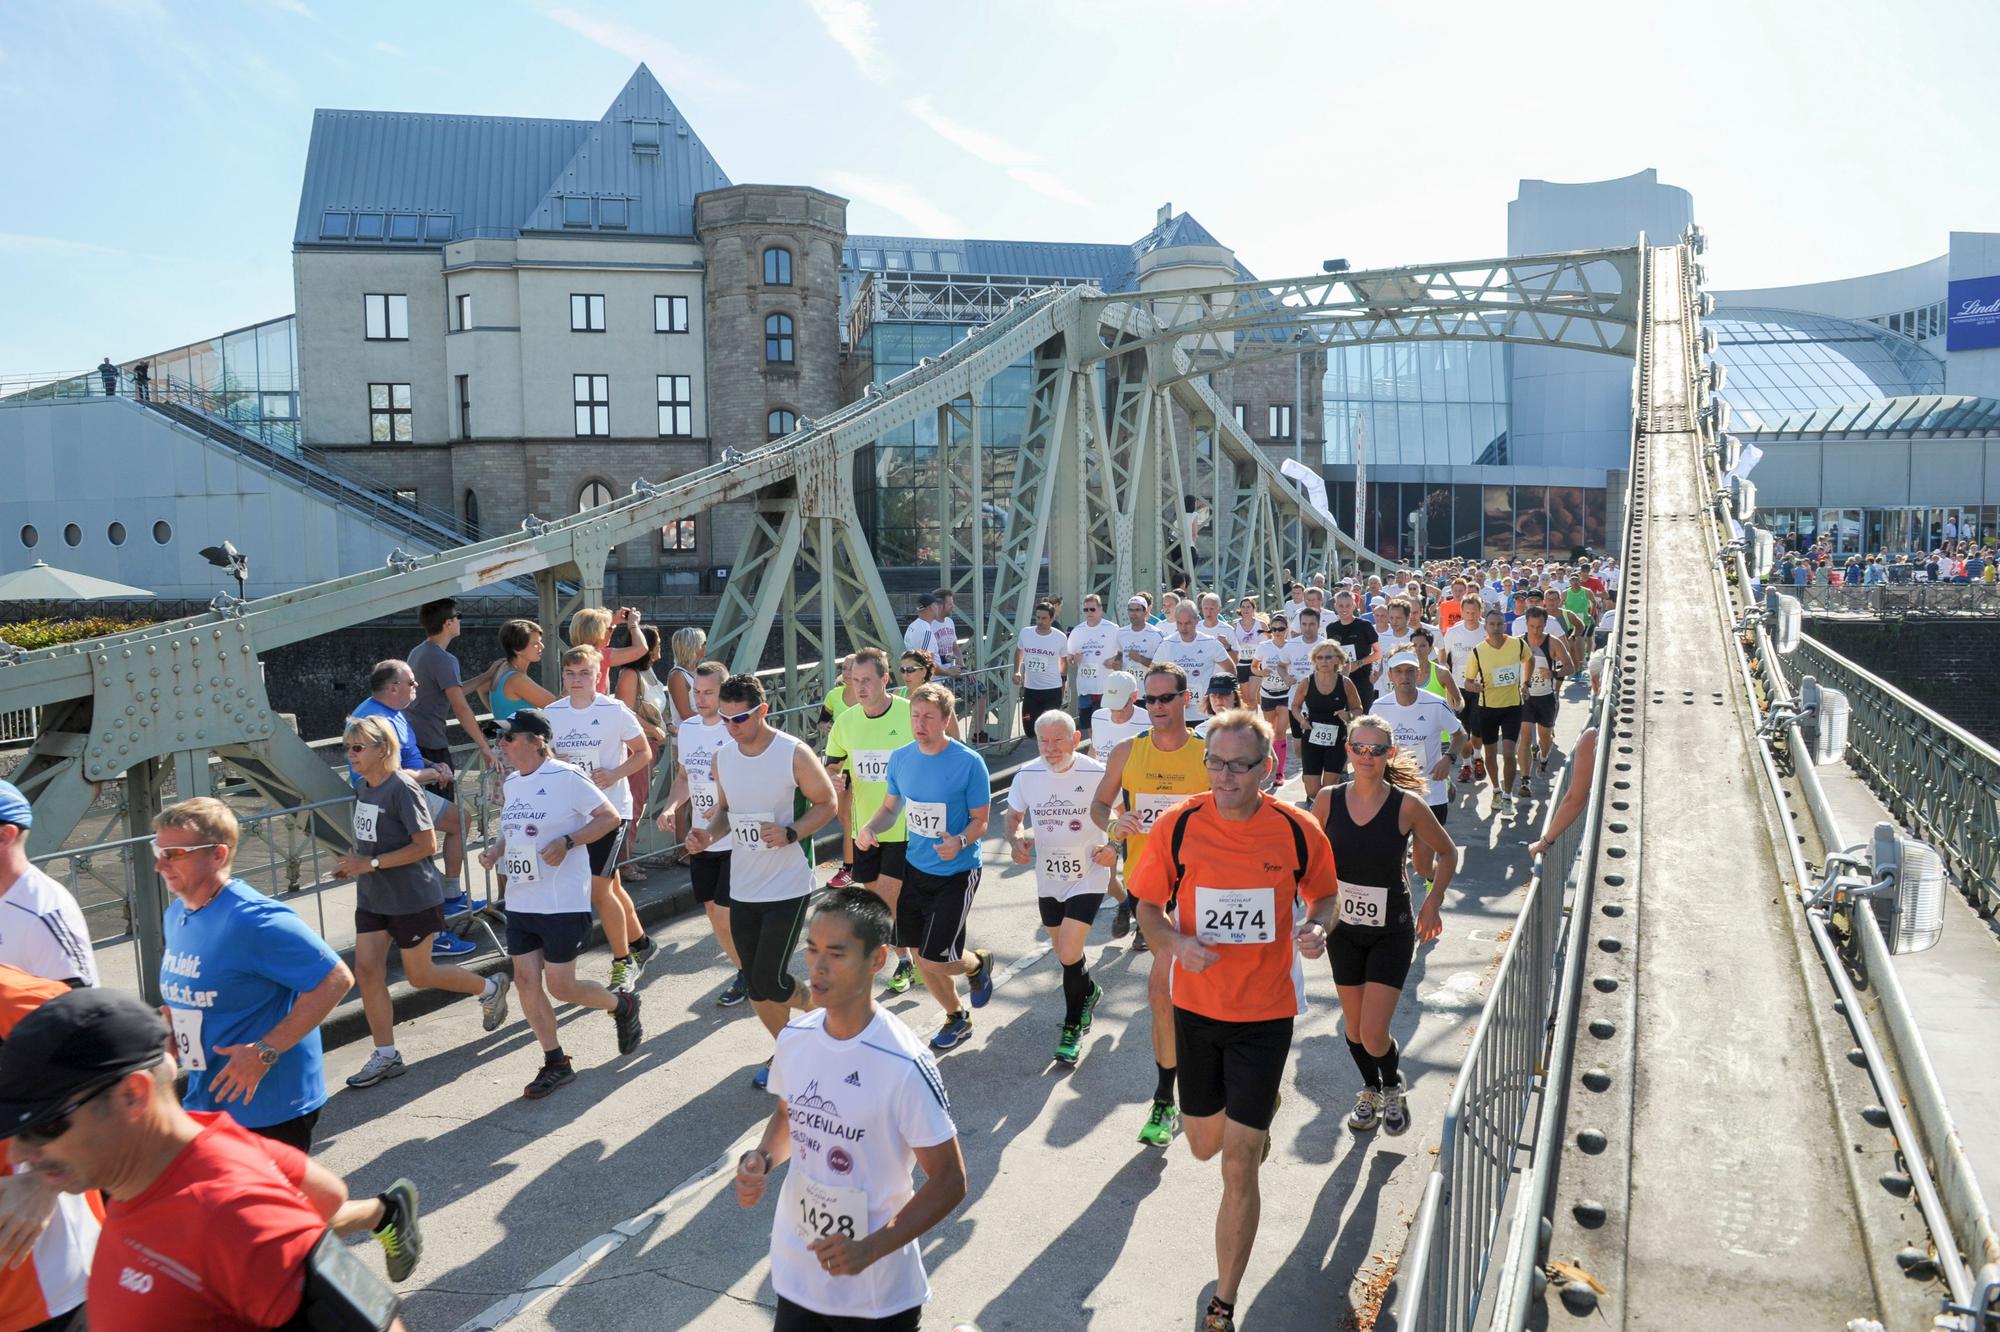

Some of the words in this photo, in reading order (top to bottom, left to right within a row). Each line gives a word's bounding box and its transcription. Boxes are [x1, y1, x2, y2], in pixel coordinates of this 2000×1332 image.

[1024, 648, 1055, 656] NISSAN
[1028, 661, 1046, 670] 2773
[1498, 672, 1516, 682] 563
[1315, 731, 1332, 741] 493
[857, 762, 888, 774] 1107
[909, 812, 940, 829] 1917
[1046, 859, 1081, 873] 2185
[1205, 909, 1266, 930] 2474
[800, 1199, 855, 1240] 1428
